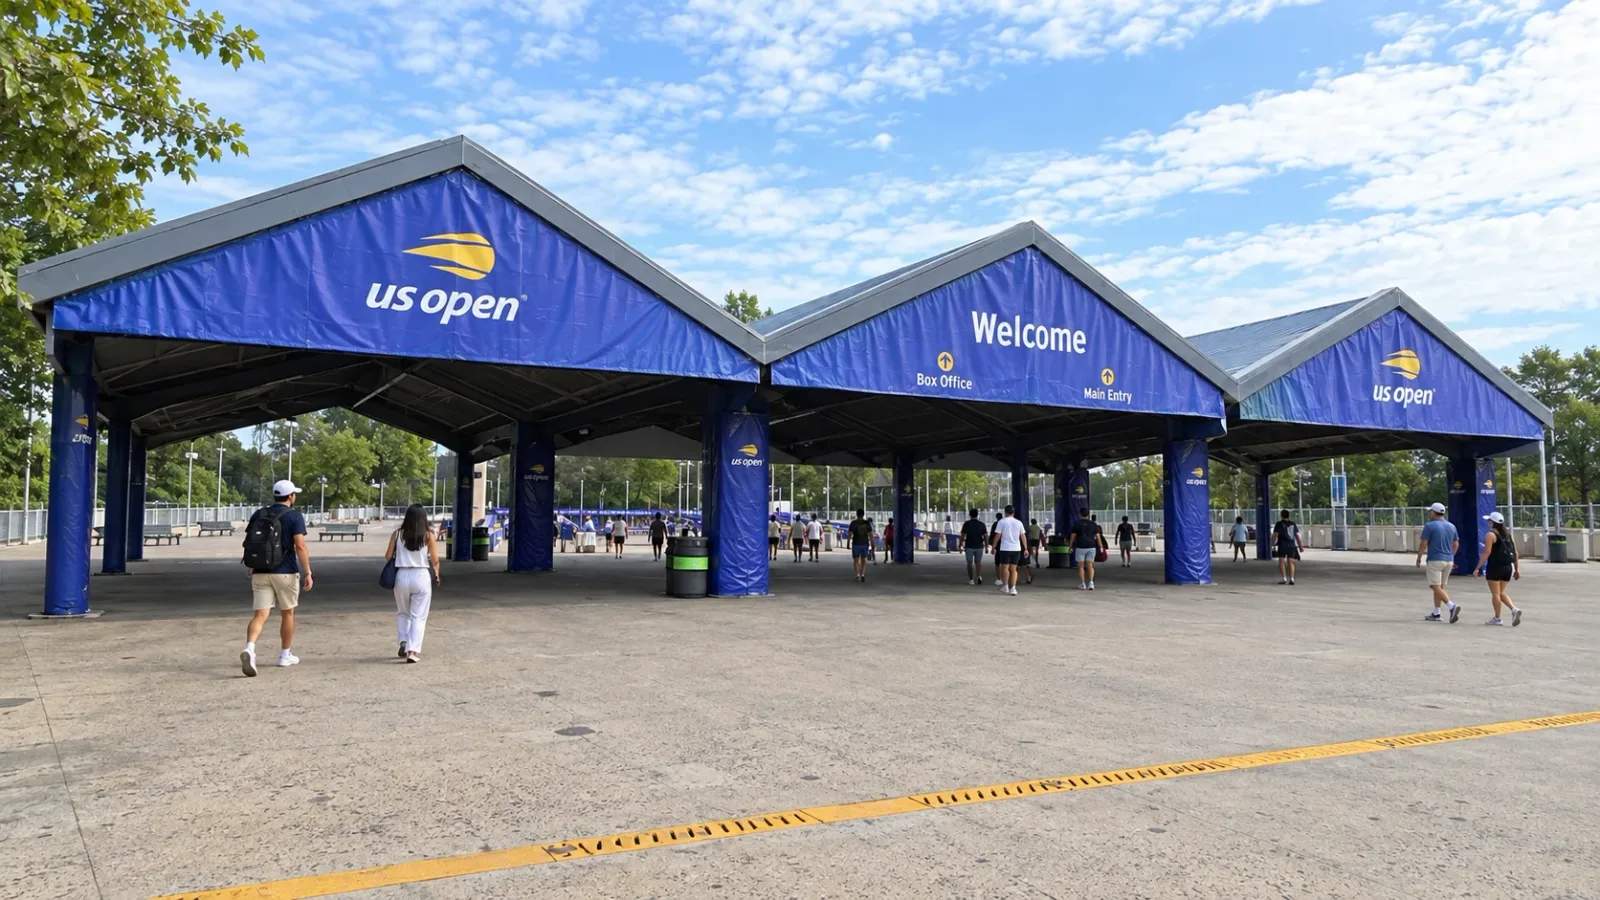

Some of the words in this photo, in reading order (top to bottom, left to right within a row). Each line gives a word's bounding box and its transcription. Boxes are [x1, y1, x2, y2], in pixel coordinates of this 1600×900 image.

[365, 282, 418, 312] us
[971, 310, 1087, 354] Welcome
[916, 372, 938, 387] Box
[940, 374, 973, 390] Office
[1083, 387, 1106, 400] Main
[1107, 388, 1133, 405] Entry
[1373, 384, 1392, 402] us
